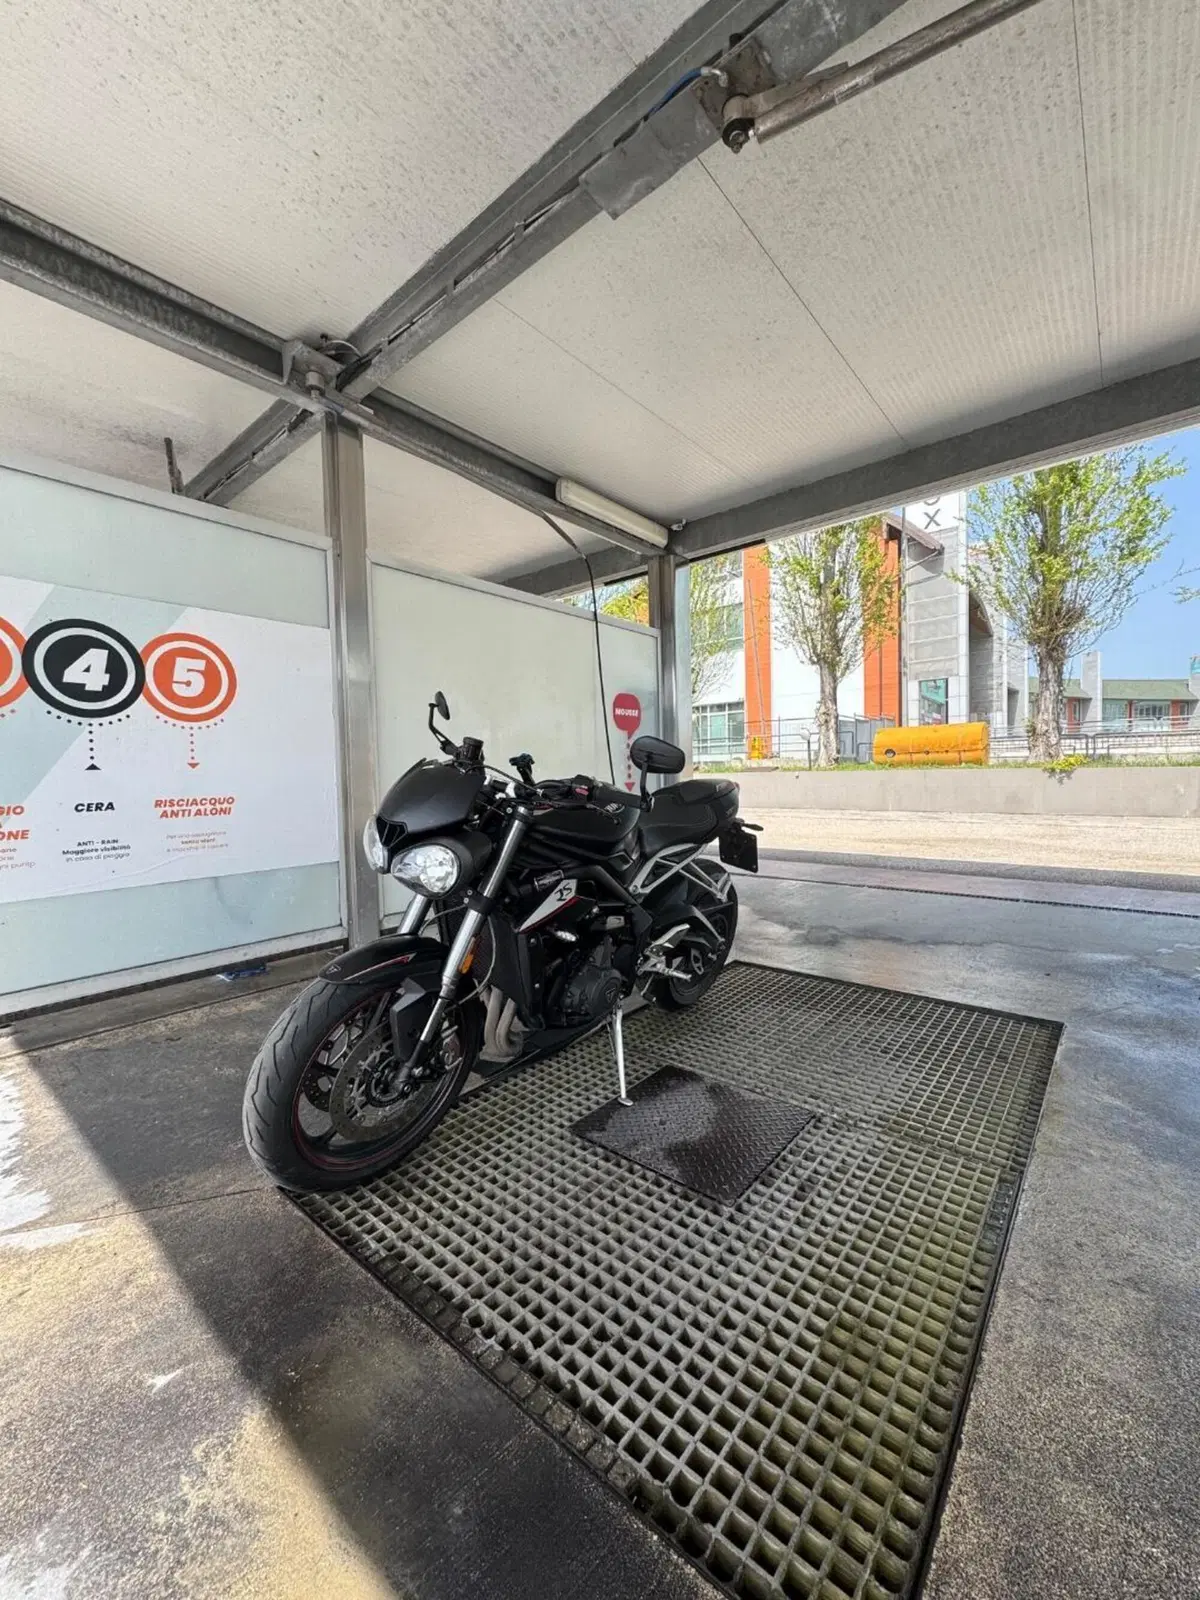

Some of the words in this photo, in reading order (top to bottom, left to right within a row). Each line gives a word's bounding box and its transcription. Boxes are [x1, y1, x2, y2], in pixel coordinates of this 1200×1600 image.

[62, 647, 110, 692] 4
[171, 656, 206, 697] 5
[615, 708, 639, 717] MOUSSE
[74, 801, 115, 813] CERA
[154, 796, 235, 808] RISCIACQUO
[160, 809, 192, 818] ANTI
[194, 807, 232, 816] ALONI
[61, 847, 99, 856] Maggiore
